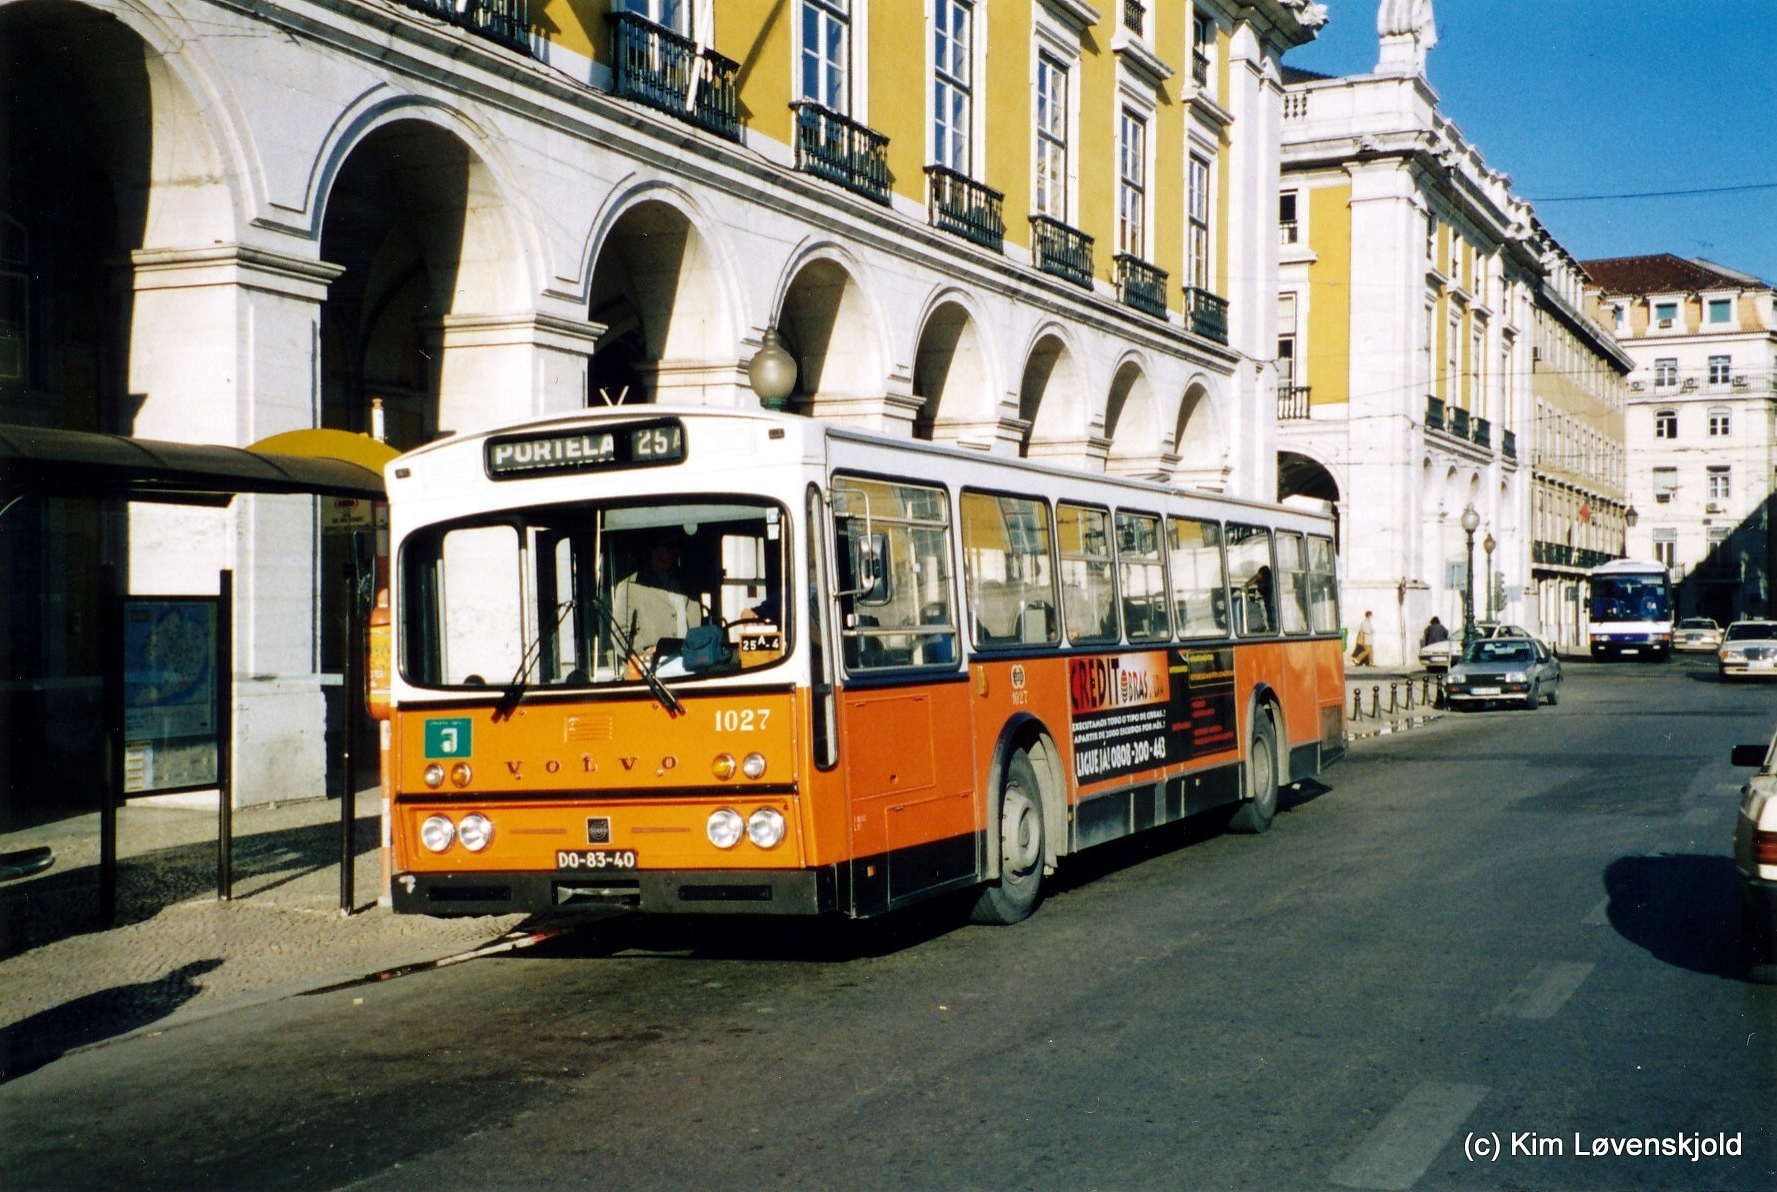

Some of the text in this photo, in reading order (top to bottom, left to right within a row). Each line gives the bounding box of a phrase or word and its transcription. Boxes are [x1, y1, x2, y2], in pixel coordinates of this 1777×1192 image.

[715, 709, 770, 731] 1027
[1108, 716, 1121, 727] TODO
[1122, 716, 1126, 724] O
[1127, 713, 1139, 723] TIPO
[1139, 712, 1146, 720] DE
[505, 756, 677, 774] VOLVO
[1076, 749, 1099, 777] LIGUE
[1100, 741, 1111, 775] JÁ!
